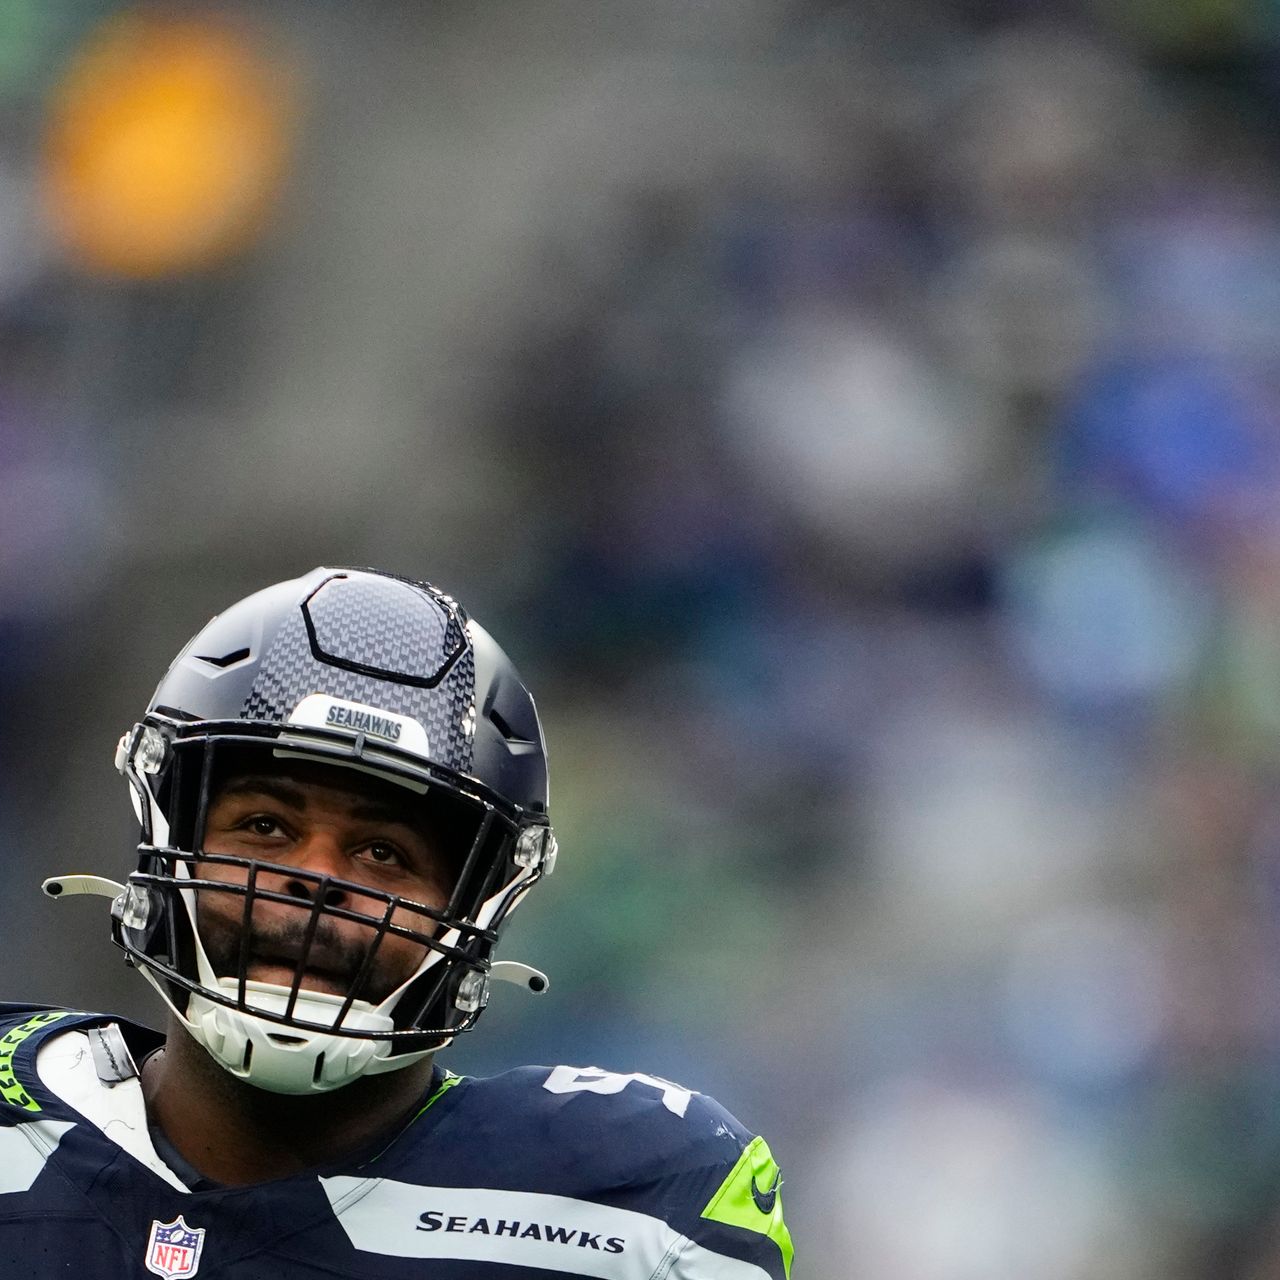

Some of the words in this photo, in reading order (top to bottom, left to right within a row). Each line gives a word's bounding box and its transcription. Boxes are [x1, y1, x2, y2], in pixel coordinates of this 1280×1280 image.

[326, 705, 402, 741] SEAHAWKS
[416, 1210, 626, 1254] SEAHAWKS
[154, 1245, 189, 1271] NFL
